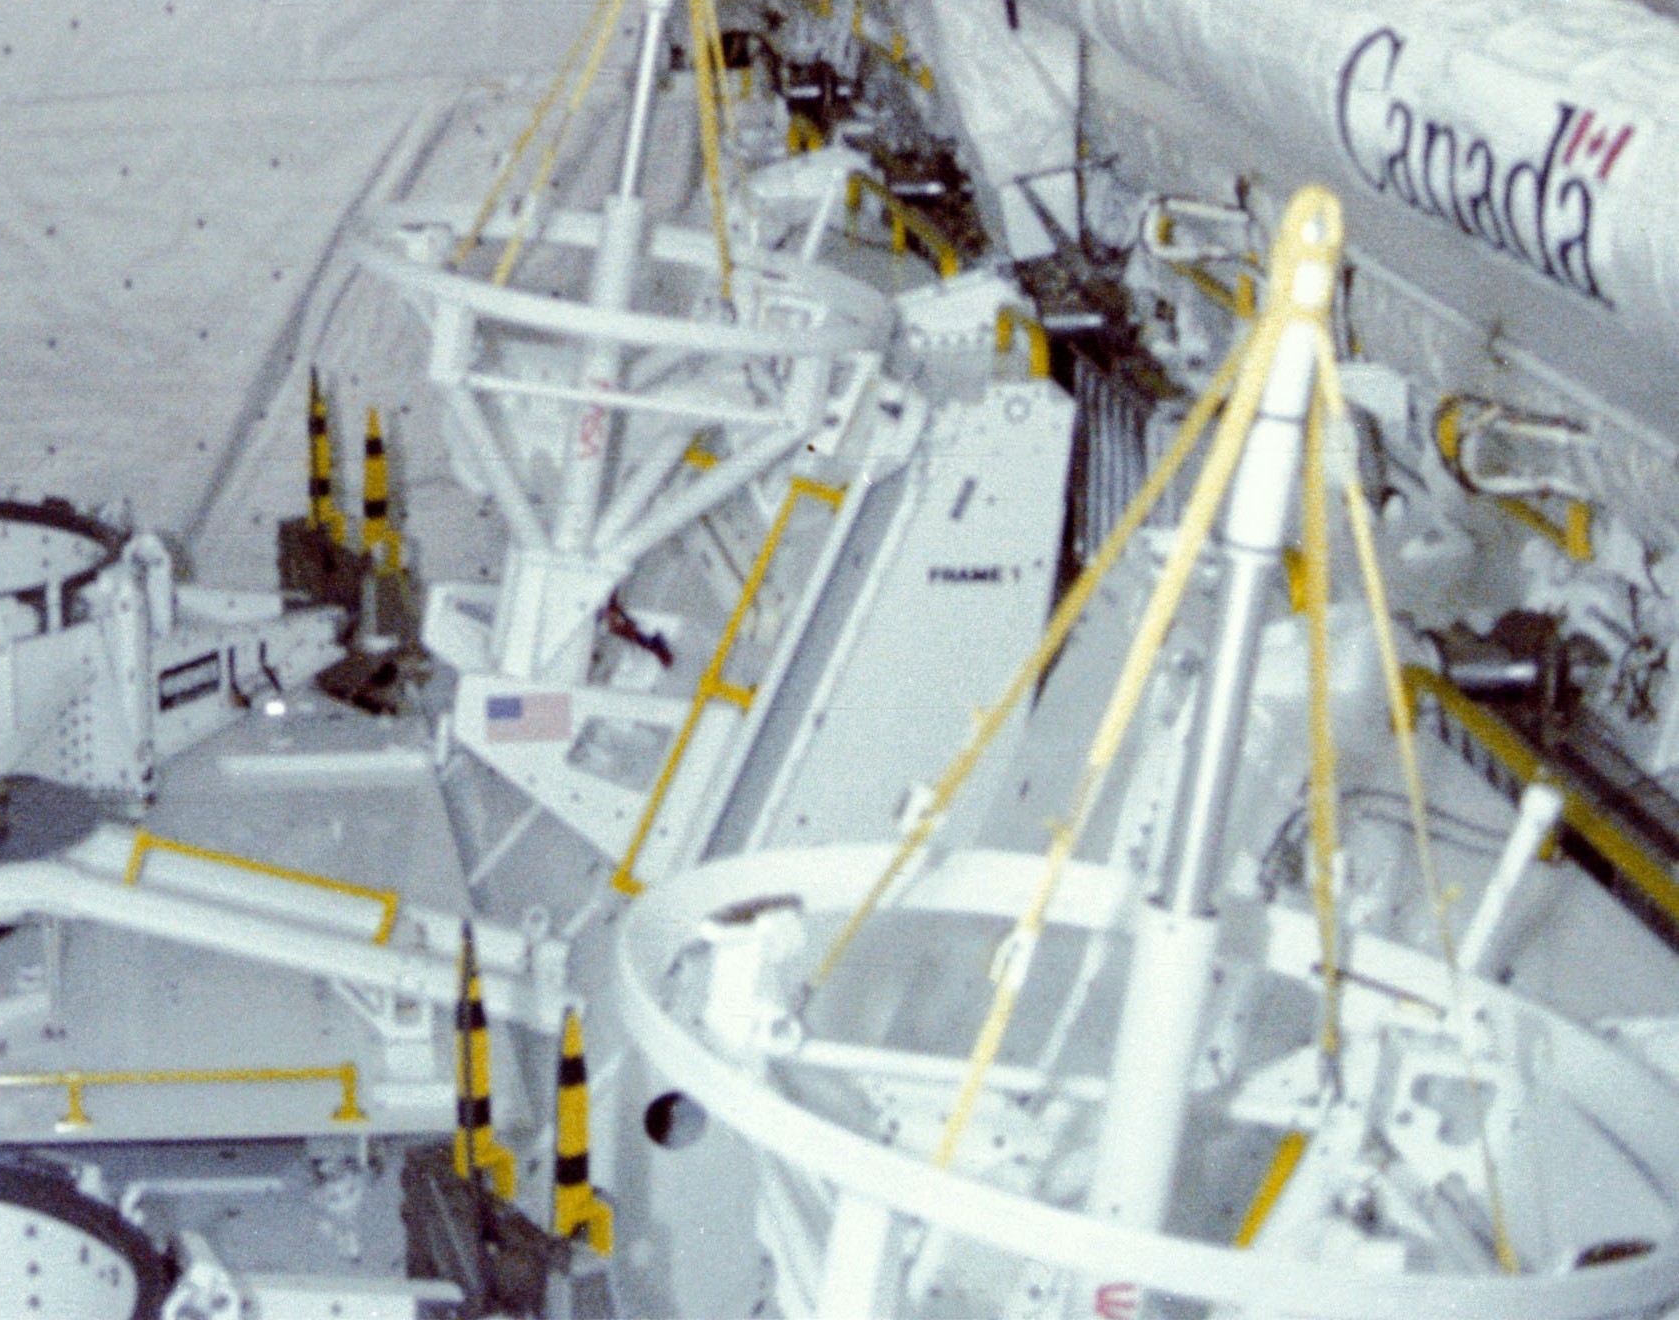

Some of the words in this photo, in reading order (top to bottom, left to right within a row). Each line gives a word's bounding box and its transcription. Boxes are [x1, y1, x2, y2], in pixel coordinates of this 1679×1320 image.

[1336, 27, 1615, 312] Canada
[927, 565, 1004, 585] FRAME
[1011, 565, 1022, 582] 1
